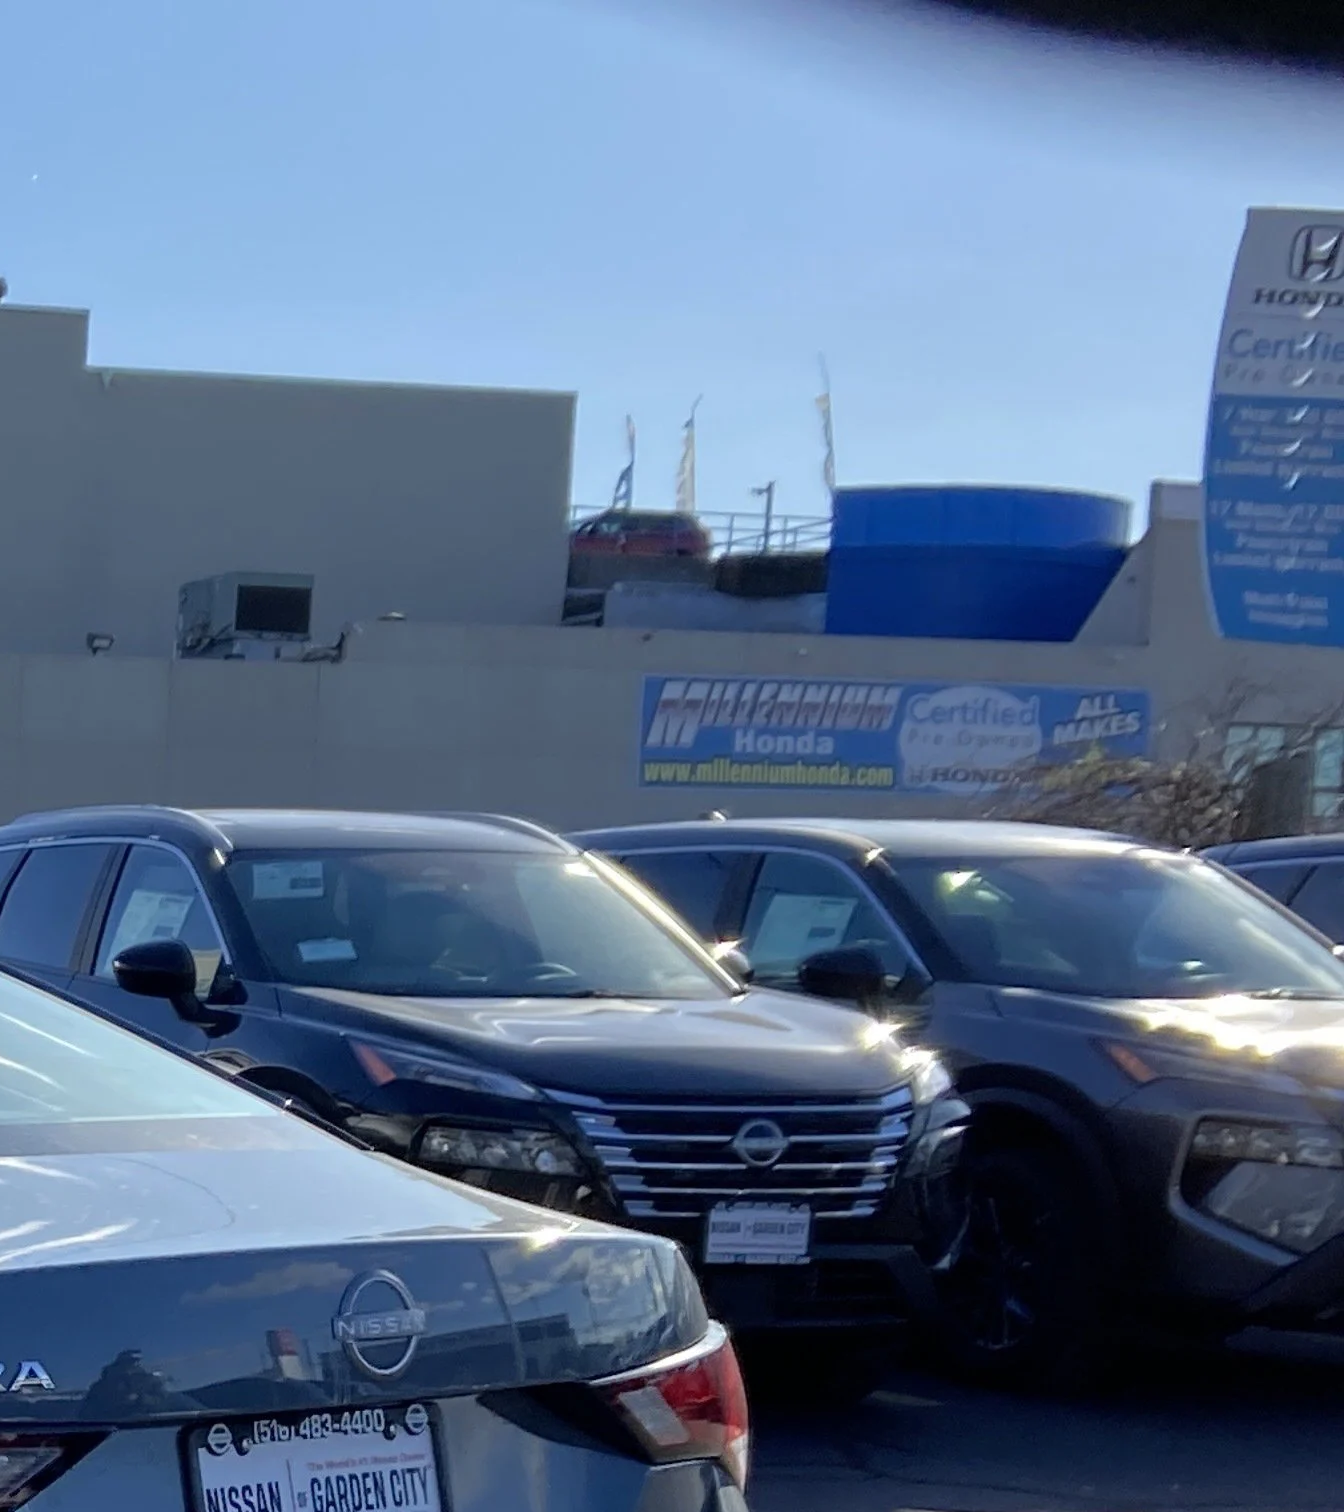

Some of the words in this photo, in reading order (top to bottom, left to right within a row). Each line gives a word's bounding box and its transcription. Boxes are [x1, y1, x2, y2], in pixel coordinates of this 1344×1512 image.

[1253, 288, 1344, 307] HOND
[1227, 328, 1344, 362] Certifie
[909, 696, 1037, 725] Certified
[1075, 692, 1120, 720] ALL
[733, 727, 835, 755] Honda
[1053, 711, 1142, 746] MAKES
[643, 757, 894, 787] www.millenniumhonda.com
[930, 767, 1014, 784] HOND
[299, 1409, 385, 1439] 483-4400
[390, 1467, 429, 1508] CITY
